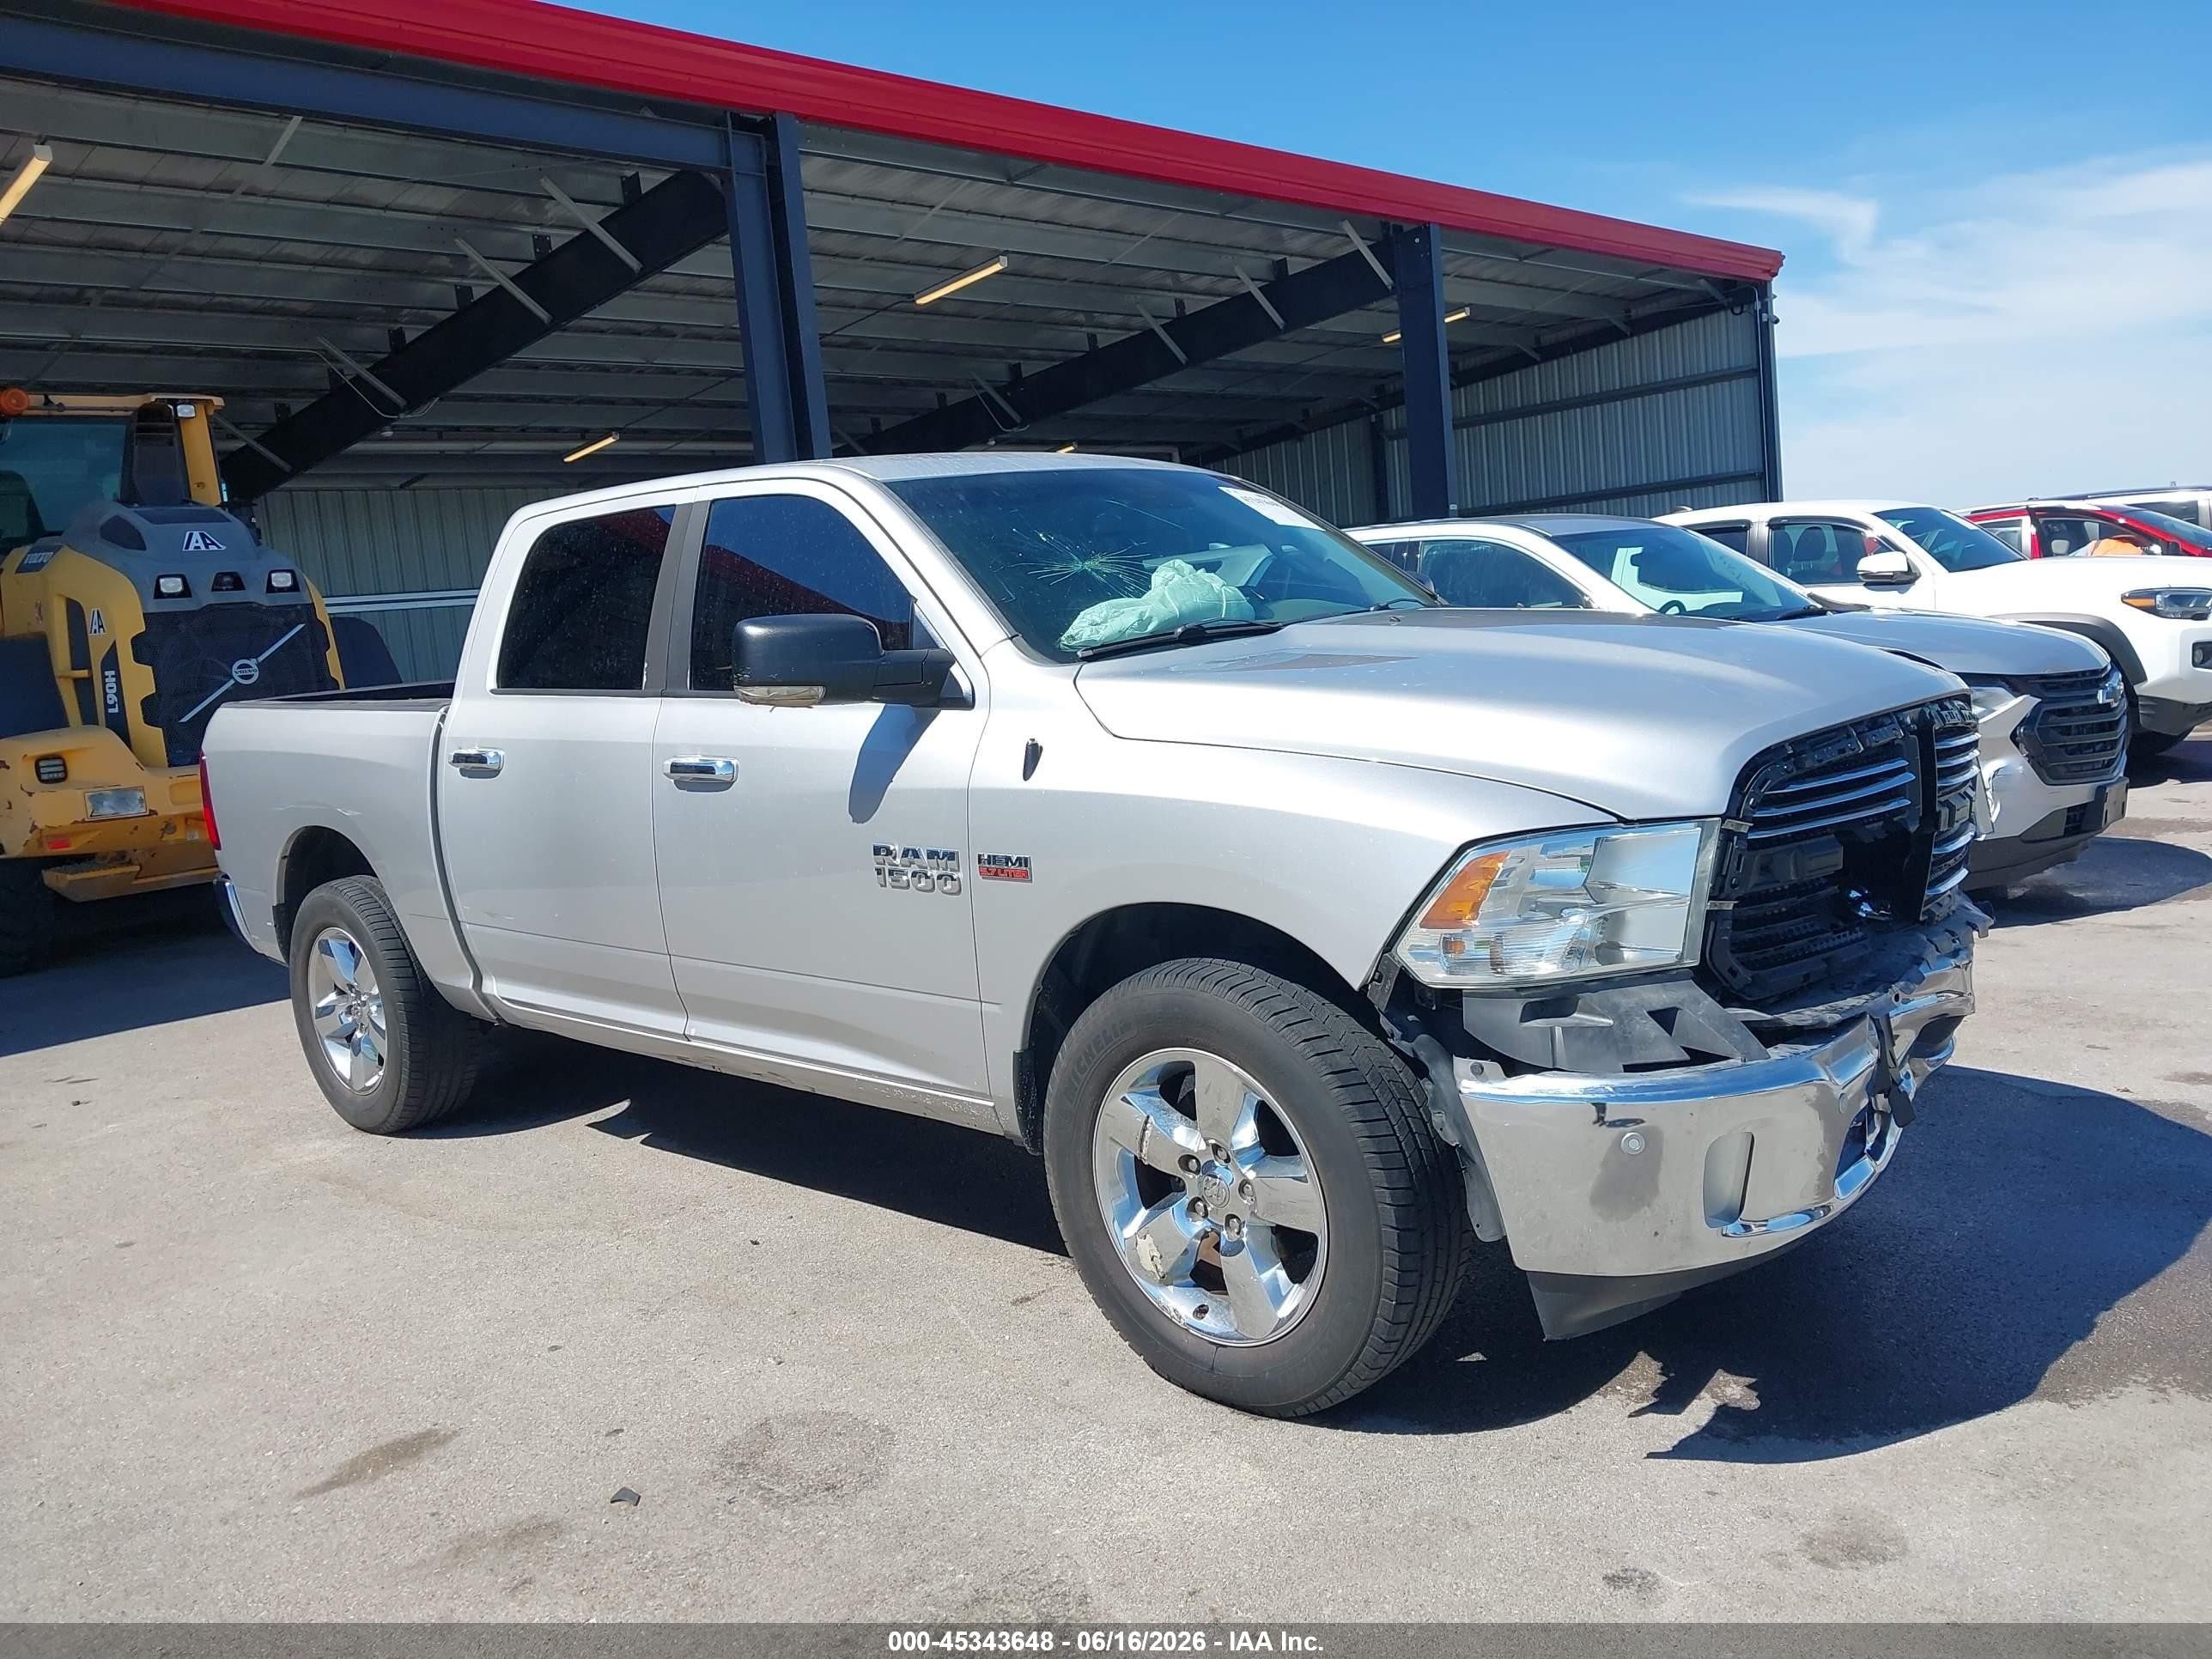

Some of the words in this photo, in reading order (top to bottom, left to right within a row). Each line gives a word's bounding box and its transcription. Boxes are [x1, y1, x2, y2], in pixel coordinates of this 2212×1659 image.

[182, 532, 226, 550] IAA
[104, 670, 119, 714] L90H
[872, 843, 961, 872] RAM
[977, 852, 1030, 868] HEMI
[874, 866, 962, 896] 1500
